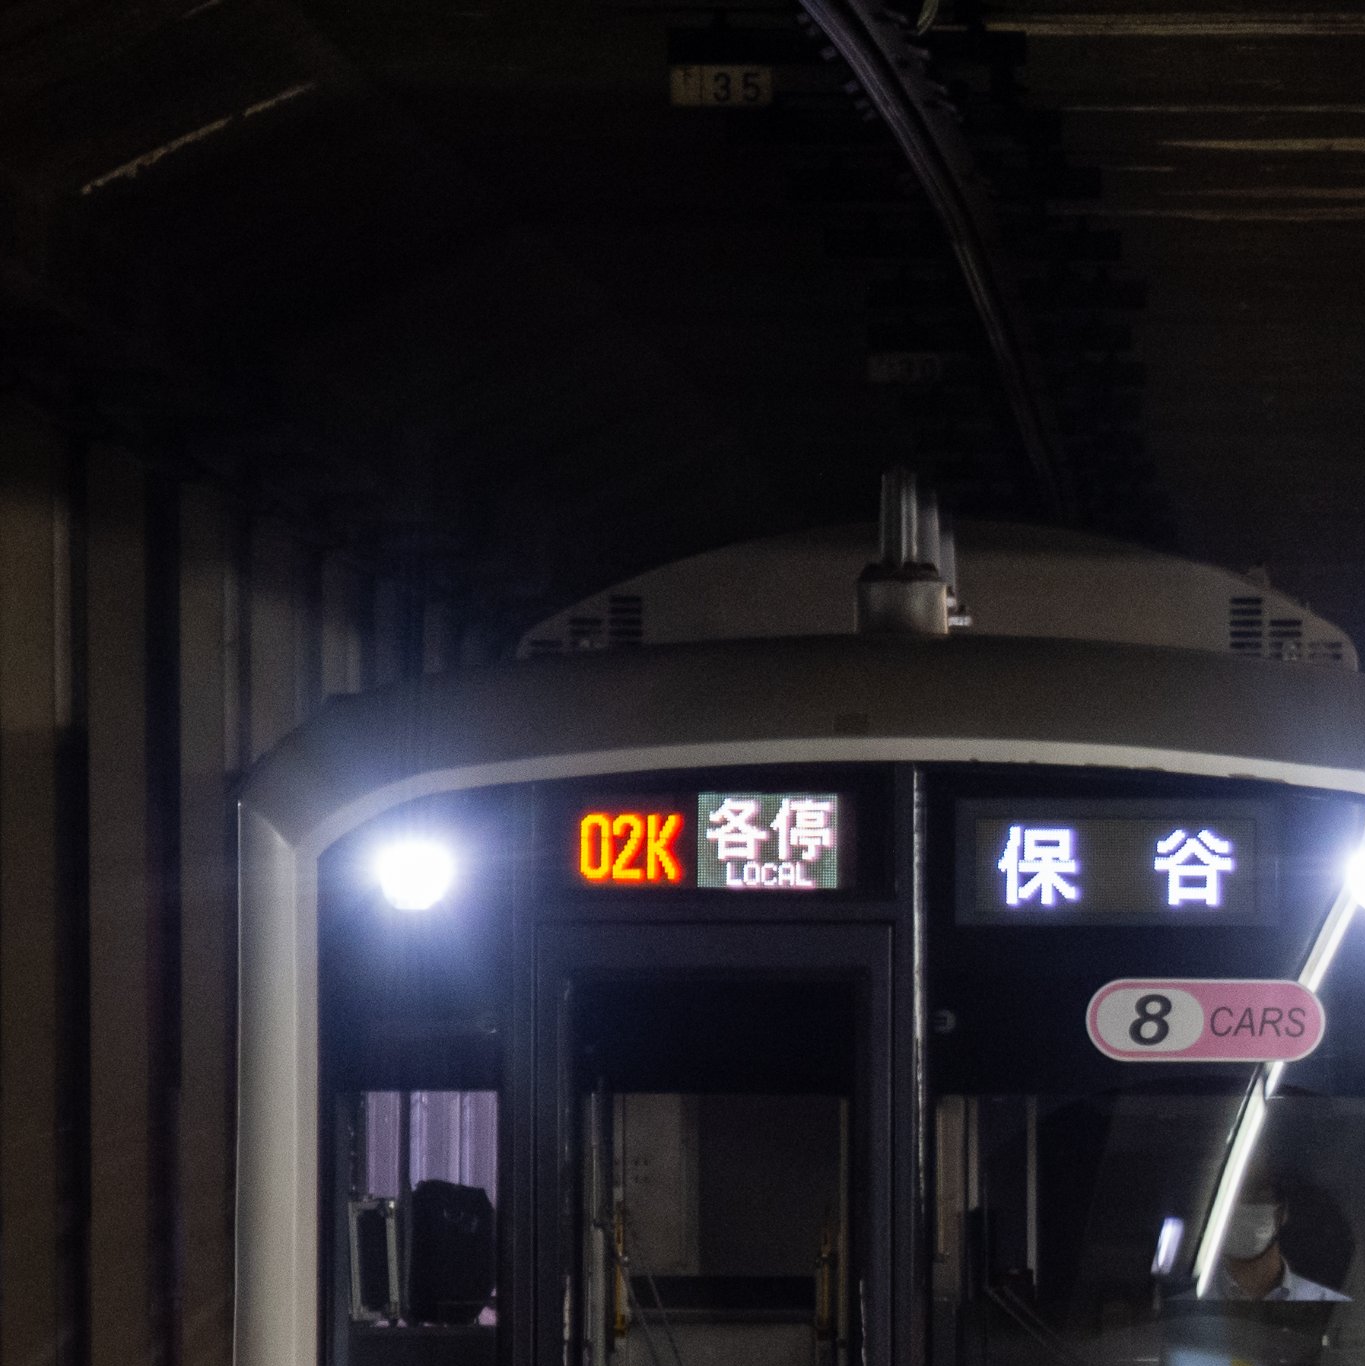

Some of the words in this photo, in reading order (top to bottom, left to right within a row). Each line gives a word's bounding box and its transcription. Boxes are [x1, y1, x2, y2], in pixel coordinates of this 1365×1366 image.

[713, 71, 761, 102] 35
[580, 814, 680, 881] 02K
[706, 797, 838, 860] 各停
[725, 861, 814, 888] LOCAL
[998, 826, 1233, 906] 保谷
[1128, 993, 1172, 1046] 8
[1210, 1006, 1306, 1037] CARS
